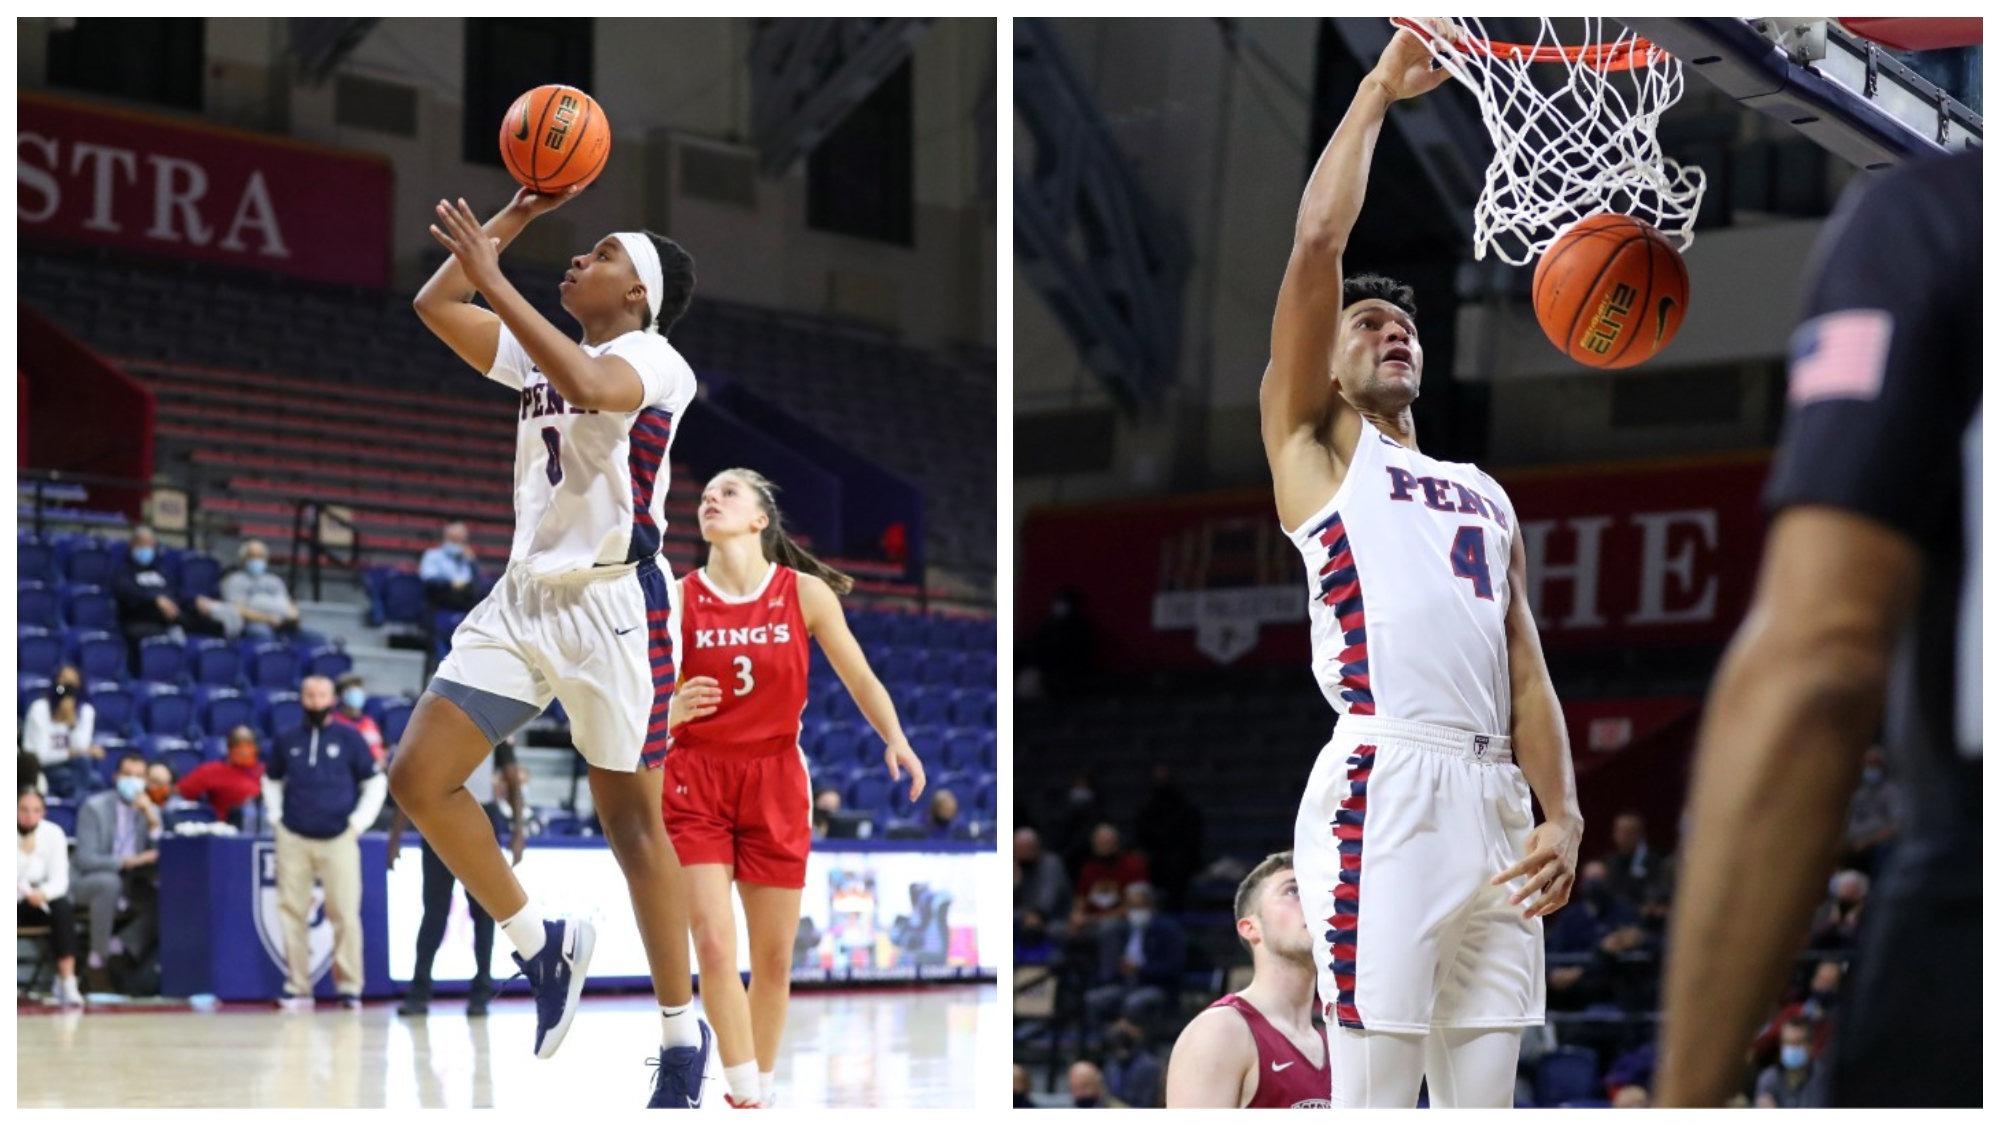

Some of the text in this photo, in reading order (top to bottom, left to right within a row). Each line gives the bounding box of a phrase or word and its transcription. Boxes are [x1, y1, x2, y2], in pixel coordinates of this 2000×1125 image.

[544, 94, 577, 151] ELITE
[17, 131, 292, 258] STRA
[1586, 283, 1638, 355] ELITE
[521, 382, 599, 421] PEN
[541, 426, 563, 487] 0
[1450, 525, 1495, 602] 4
[695, 622, 791, 649] KING'S
[732, 654, 755, 697] 3
